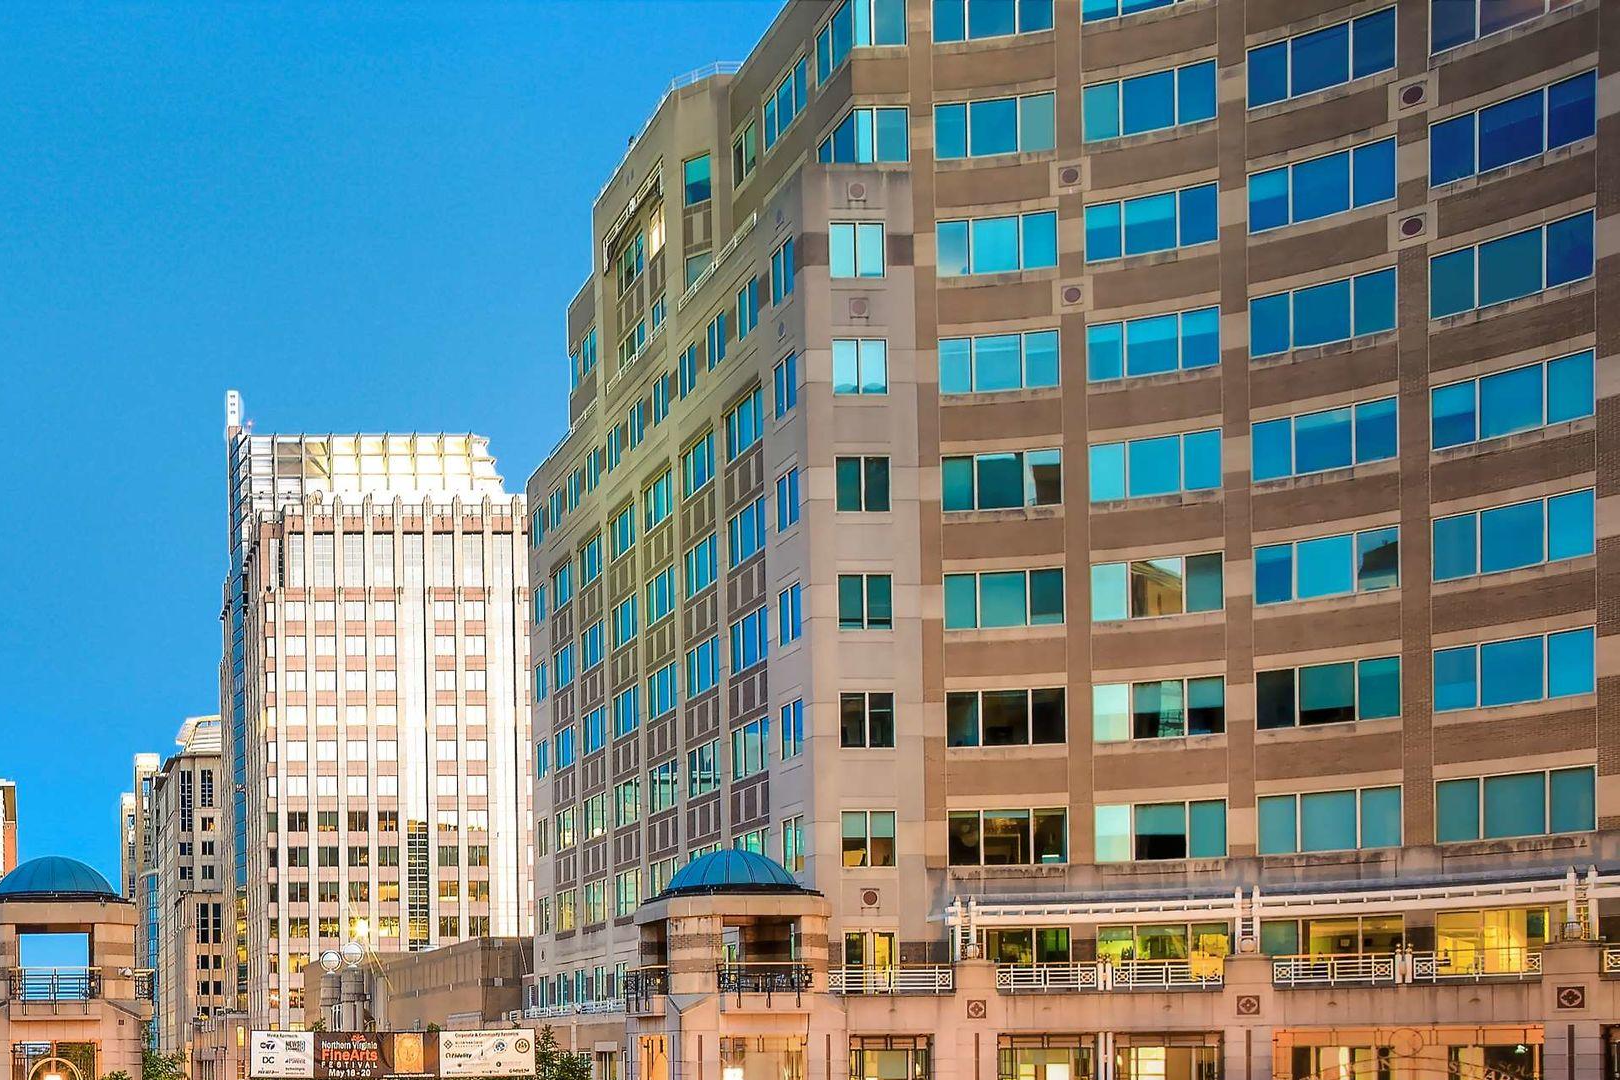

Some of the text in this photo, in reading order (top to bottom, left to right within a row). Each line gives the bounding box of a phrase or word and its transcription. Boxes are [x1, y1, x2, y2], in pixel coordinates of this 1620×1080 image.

[321, 1041, 378, 1051] Northern Virginia
[321, 1050, 378, 1061] FineArts
[321, 1061, 378, 1069] FESTIVAL
[328, 1069, 345, 1079] May
